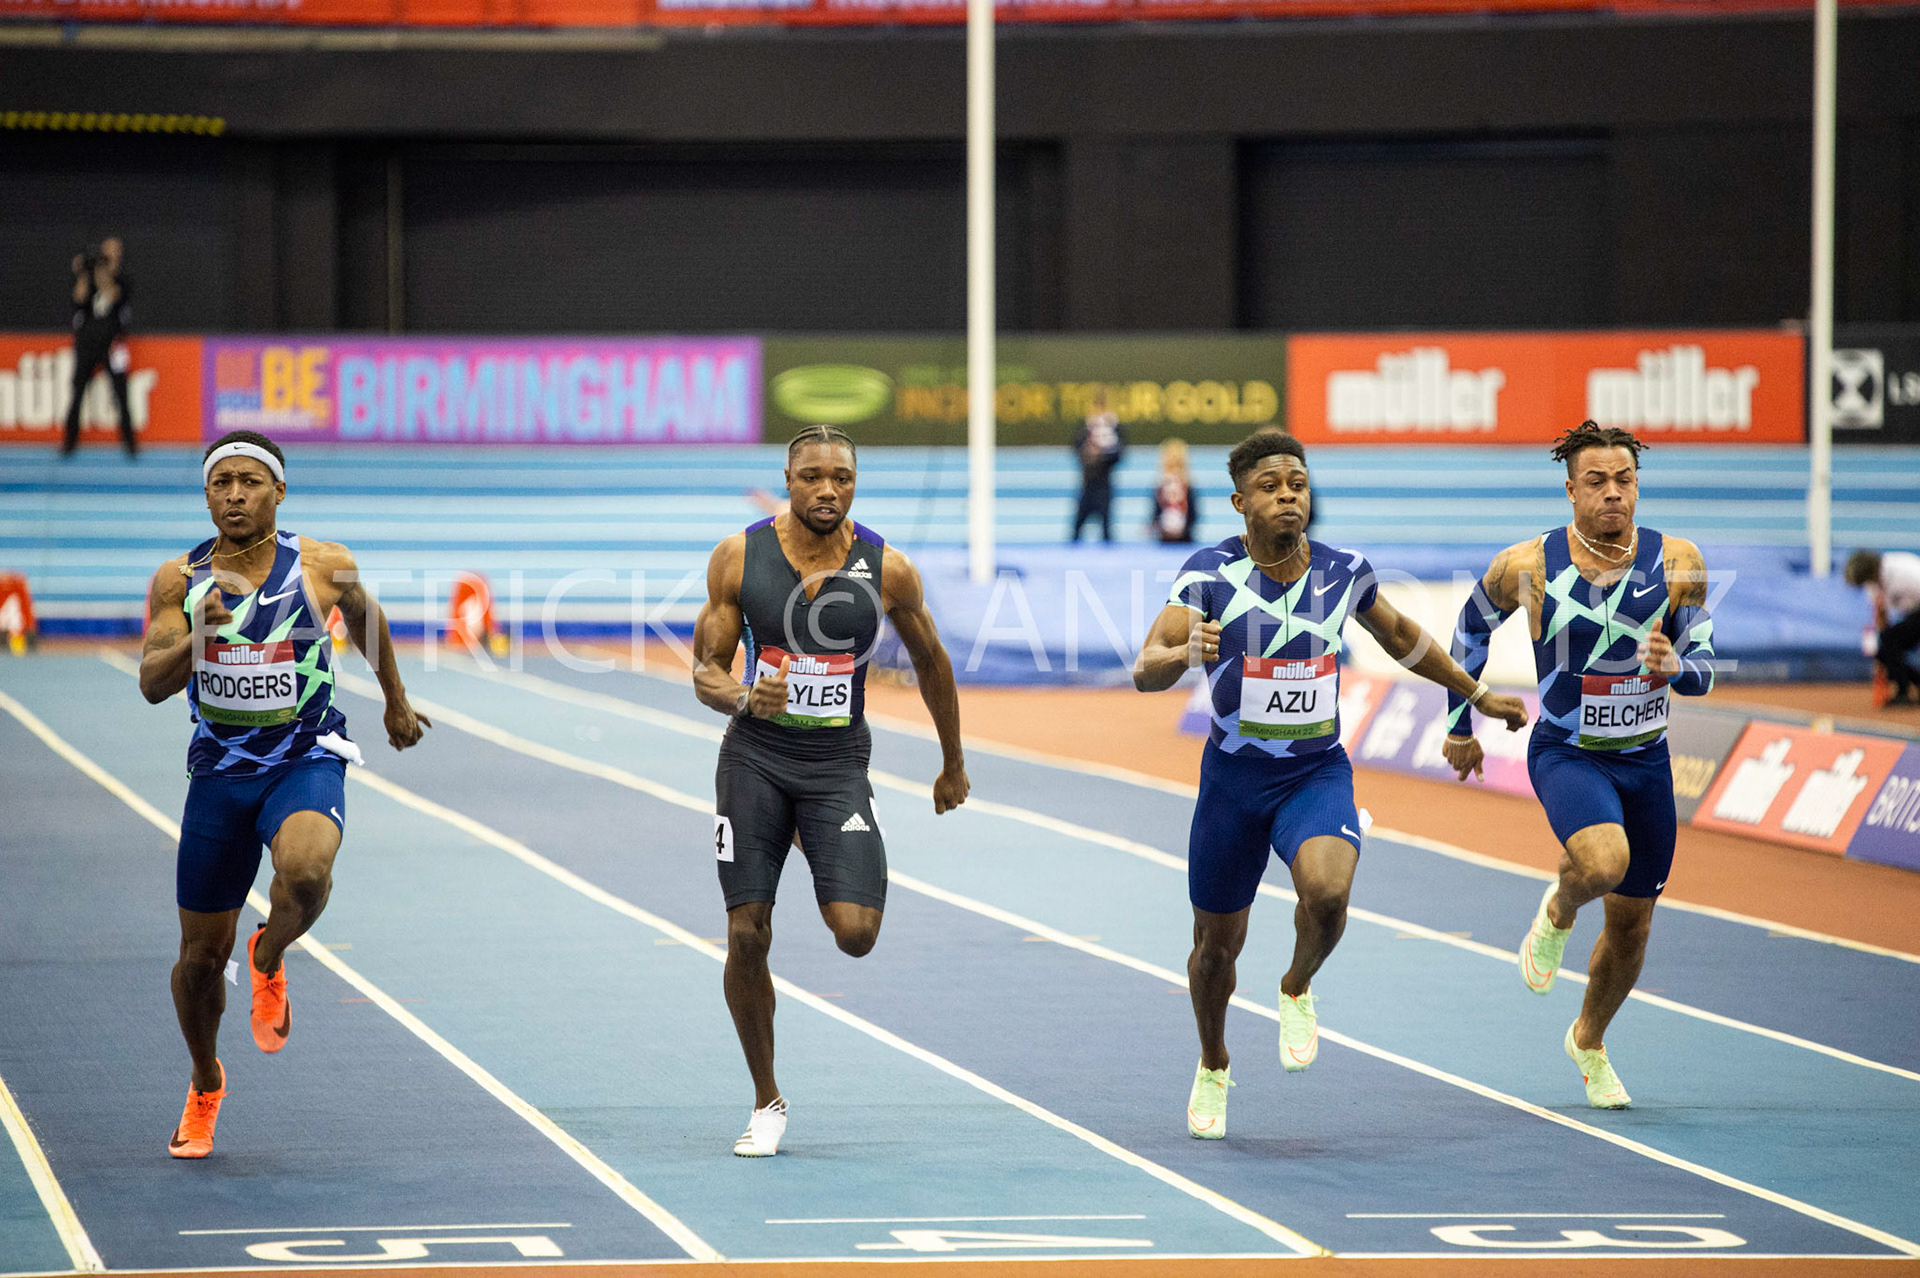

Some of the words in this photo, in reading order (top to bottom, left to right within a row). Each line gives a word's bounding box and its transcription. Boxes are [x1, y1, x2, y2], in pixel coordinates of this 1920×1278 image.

[340, 354, 750, 438] BIRMINGHAM
[1327, 346, 1505, 433] müller
[1587, 345, 1759, 432] müller
[1163, 380, 1279, 424] GOLD
[218, 645, 265, 664] müller
[1273, 662, 1317, 679] müller
[200, 671, 292, 699] RODGERS
[787, 683, 847, 707] YLES
[1611, 677, 1652, 695] müller
[1265, 690, 1317, 713] AZU
[1584, 697, 1665, 727] BELCHER
[1242, 725, 1301, 736] BIRMINGHAM
[1303, 727, 1314, 736] 22
[715, 823, 725, 854] 4
[840, 824, 870, 832] adidas
[245, 1236, 564, 1261] 5
[854, 1230, 1154, 1252] 4
[1430, 1225, 1748, 1248] 3
